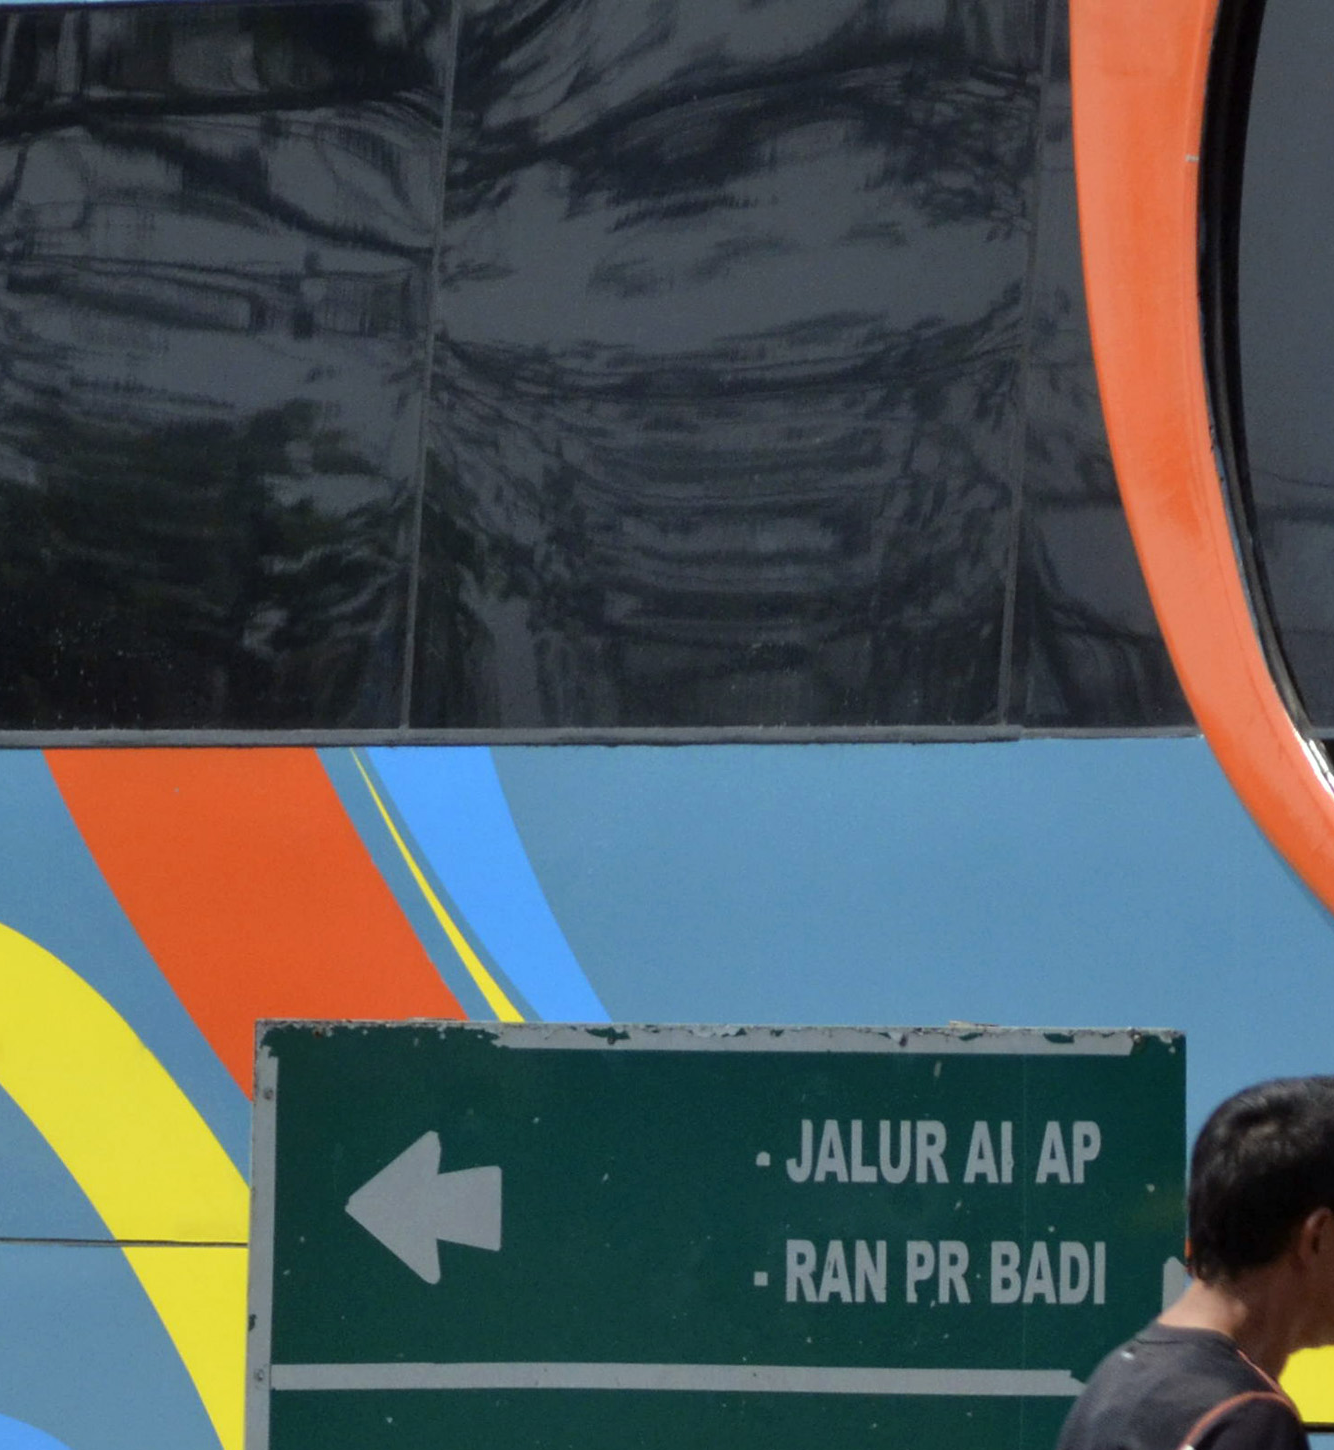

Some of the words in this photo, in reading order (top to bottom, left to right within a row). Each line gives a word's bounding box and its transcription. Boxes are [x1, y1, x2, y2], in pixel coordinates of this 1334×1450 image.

[785, 1118, 950, 1184] JALUR
[963, 1120, 1014, 1184] AI
[1035, 1120, 1102, 1184] AP
[785, 1238, 888, 1304] RAN
[905, 1239, 971, 1304] PR
[989, 1240, 1107, 1305] BADI
